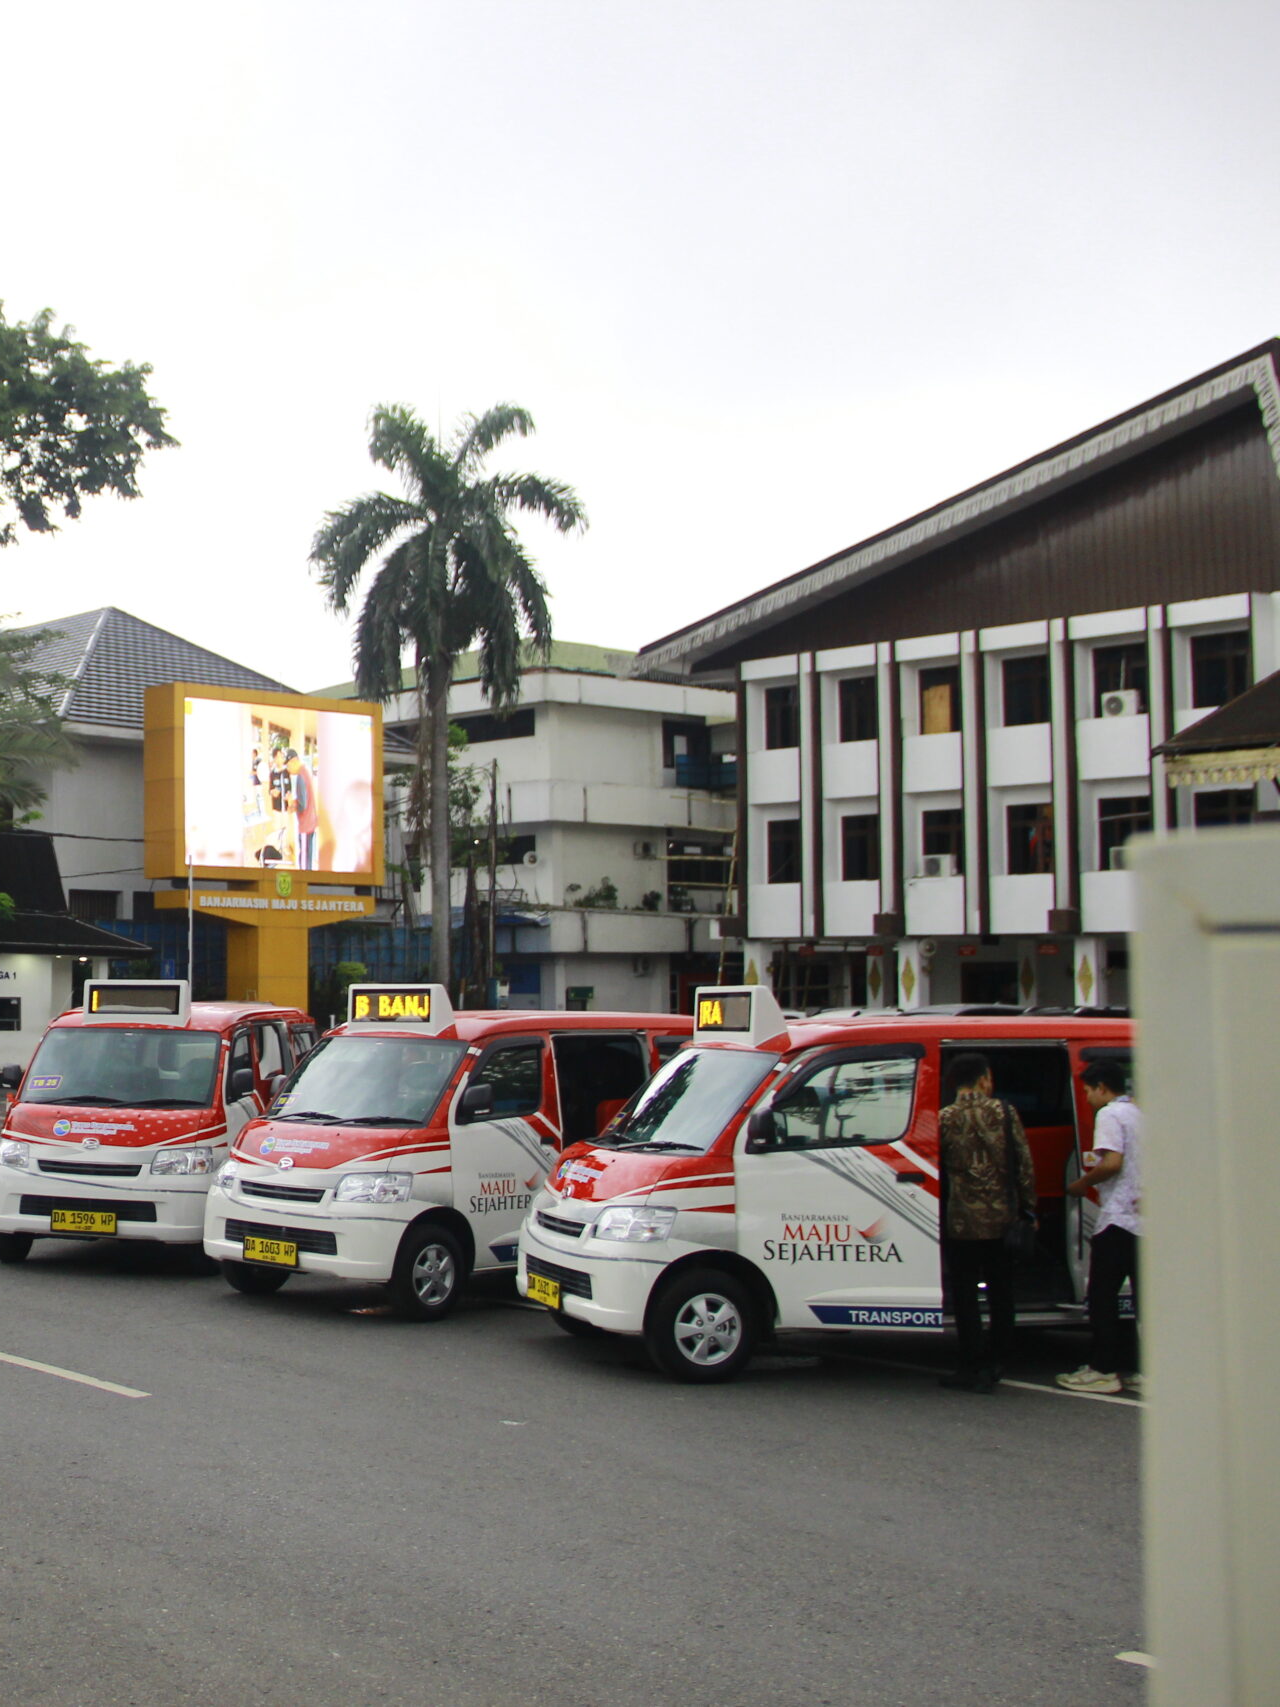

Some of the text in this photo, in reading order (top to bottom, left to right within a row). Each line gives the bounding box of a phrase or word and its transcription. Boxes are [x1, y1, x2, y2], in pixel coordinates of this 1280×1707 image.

[199, 896, 365, 912] BANJARMASIN MAJU SEJAHTERA
[378, 995, 430, 1017] BANJ
[480, 1179, 516, 1197] MAJU
[52, 1211, 114, 1226] DA 1596 WP
[780, 1213, 849, 1222] BANJARMASIN
[782, 1223, 851, 1245] MAJU
[245, 1238, 295, 1257] DA 1603 WP
[763, 1239, 904, 1265] SEJAHTERA
